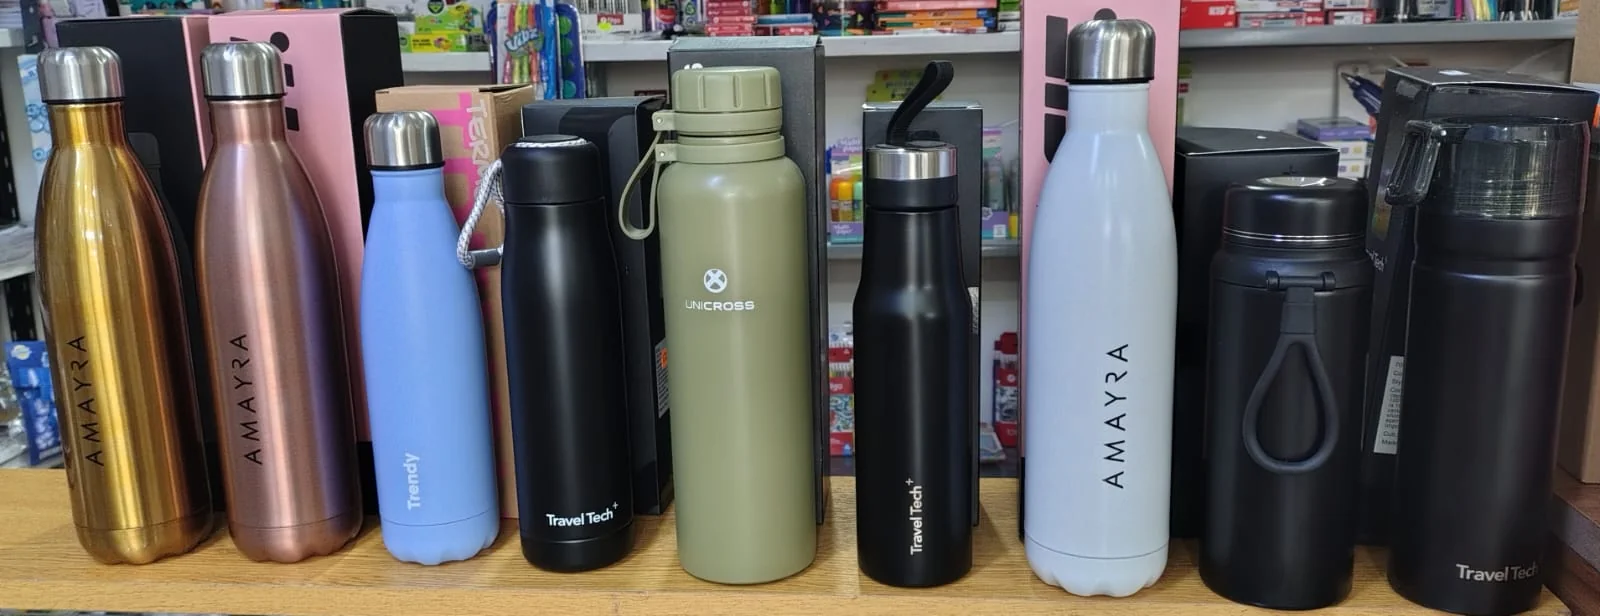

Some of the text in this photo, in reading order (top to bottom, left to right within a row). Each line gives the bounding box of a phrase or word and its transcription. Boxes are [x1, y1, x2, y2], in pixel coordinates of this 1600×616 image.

[685, 300, 755, 311] UNICROSS
[67, 336, 104, 466] AMAYRA
[229, 334, 262, 465] AMAYRA
[1102, 344, 1129, 489] AMAYRA
[403, 452, 420, 510] Trendy
[546, 513, 584, 526] Travel
[910, 517, 922, 555] Travel
[1456, 563, 1508, 582] Travel
